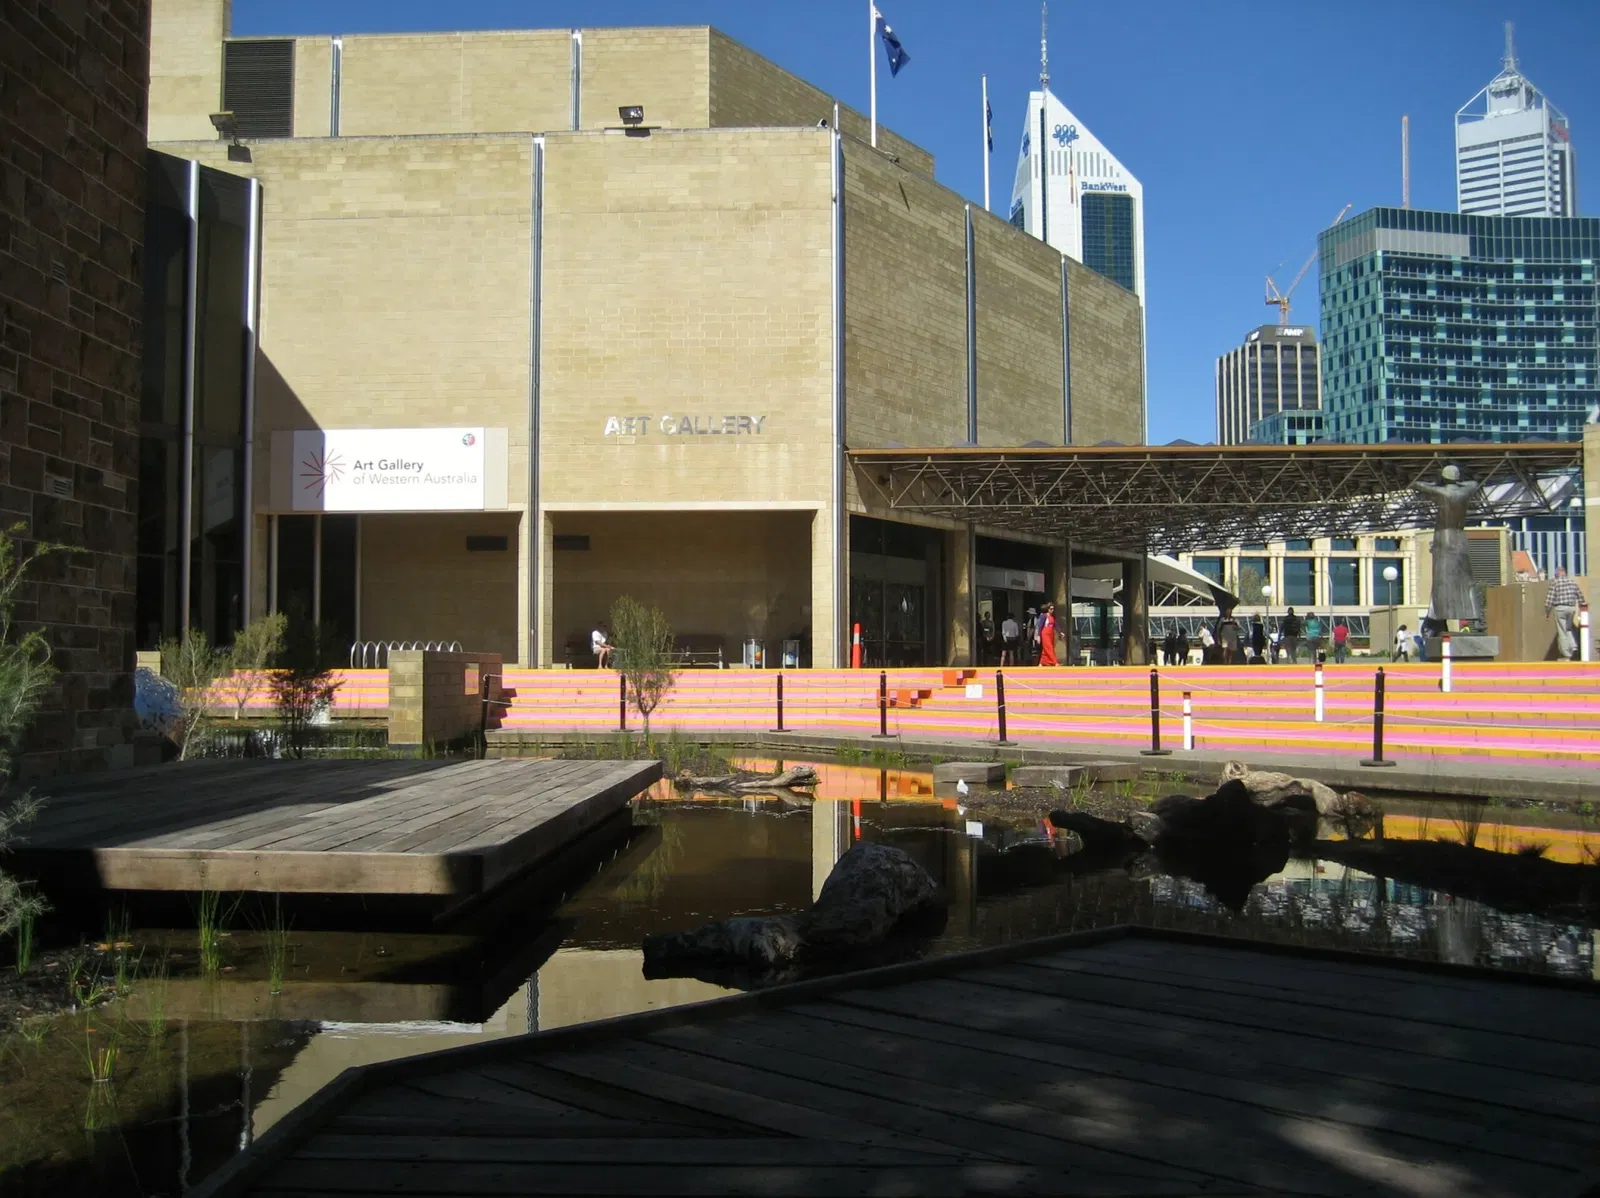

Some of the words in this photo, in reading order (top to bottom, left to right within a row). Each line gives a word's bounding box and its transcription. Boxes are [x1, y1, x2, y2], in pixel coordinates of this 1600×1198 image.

[1081, 181, 1127, 191] BankWest
[1283, 328, 1303, 336] AMP
[604, 415, 651, 436] ART
[660, 415, 766, 435] GALLERY
[353, 460, 374, 471] Art
[378, 459, 424, 473] Gallery
[353, 473, 366, 485] of
[369, 473, 420, 485] Western
[423, 472, 478, 484] Australia
